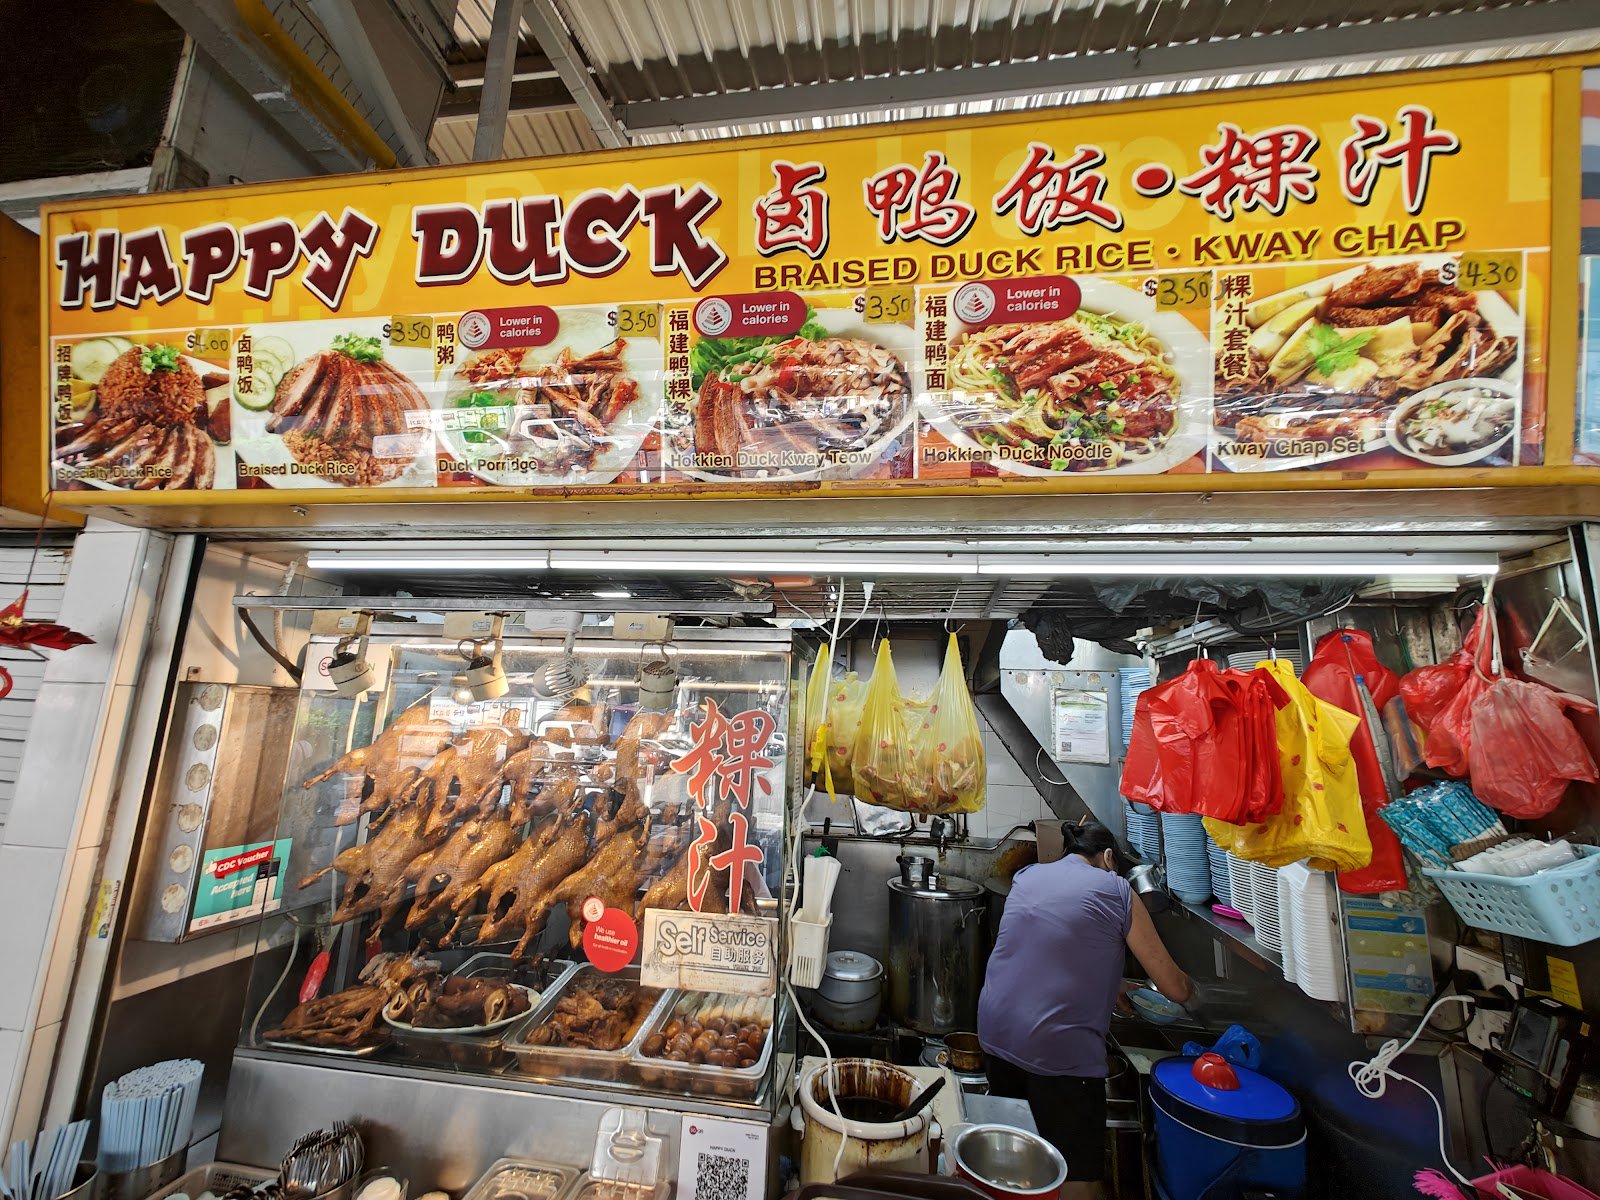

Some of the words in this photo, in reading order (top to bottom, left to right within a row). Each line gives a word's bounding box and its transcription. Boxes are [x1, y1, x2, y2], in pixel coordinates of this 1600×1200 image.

[55, 206, 380, 309] HAPPY
[411, 181, 729, 292] DUCK
[755, 257, 918, 287] BRAISED
[931, 248, 1041, 279] DUCK
[1057, 241, 1152, 269] RICE
[1194, 230, 1321, 262] KWAY
[1333, 220, 1464, 252] CHAP
[1007, 288, 1046, 300] Lower
[1049, 286, 1061, 297] in
[742, 302, 777, 314] Lower
[779, 302, 790, 312] in
[1007, 299, 1059, 312] calories
[499, 317, 531, 327] Lower
[533, 315, 543, 325] in
[742, 313, 789, 325] calories
[1223, 274, 1252, 378] 粿汁套餐
[499, 326, 541, 338] calories
[437, 322, 455, 365] 鸭粥
[925, 295, 948, 390] 福建鸭面
[237, 334, 253, 394] 卤鸭饭
[56, 345, 73, 422] 招牌鸭饭
[924, 447, 993, 462] Hokkien
[999, 447, 1043, 461] Duck
[1049, 445, 1113, 460] Noodle
[1217, 440, 1272, 458] Kway
[1275, 439, 1328, 457] Chap
[1331, 438, 1365, 454] Set
[240, 463, 287, 476] Braised
[290, 463, 323, 475] Duck
[325, 462, 355, 474] Rice
[438, 458, 473, 472] Duck
[477, 458, 538, 473] Porridge
[671, 452, 732, 467] Hokkien
[736, 452, 776, 466] Duck
[781, 452, 825, 468] Kway
[830, 451, 872, 464] Teow
[58, 467, 110, 480] Specialty
[113, 466, 144, 478] Duck
[146, 466, 172, 478] Rice
[671, 697, 777, 914] 粿汁
[217, 860, 236, 872] CDC
[237, 850, 269, 866] Voucher
[210, 873, 254, 896] Accepted
[659, 920, 706, 957] Self
[709, 924, 766, 947] Service
[711, 945, 765, 966] 自助服务
